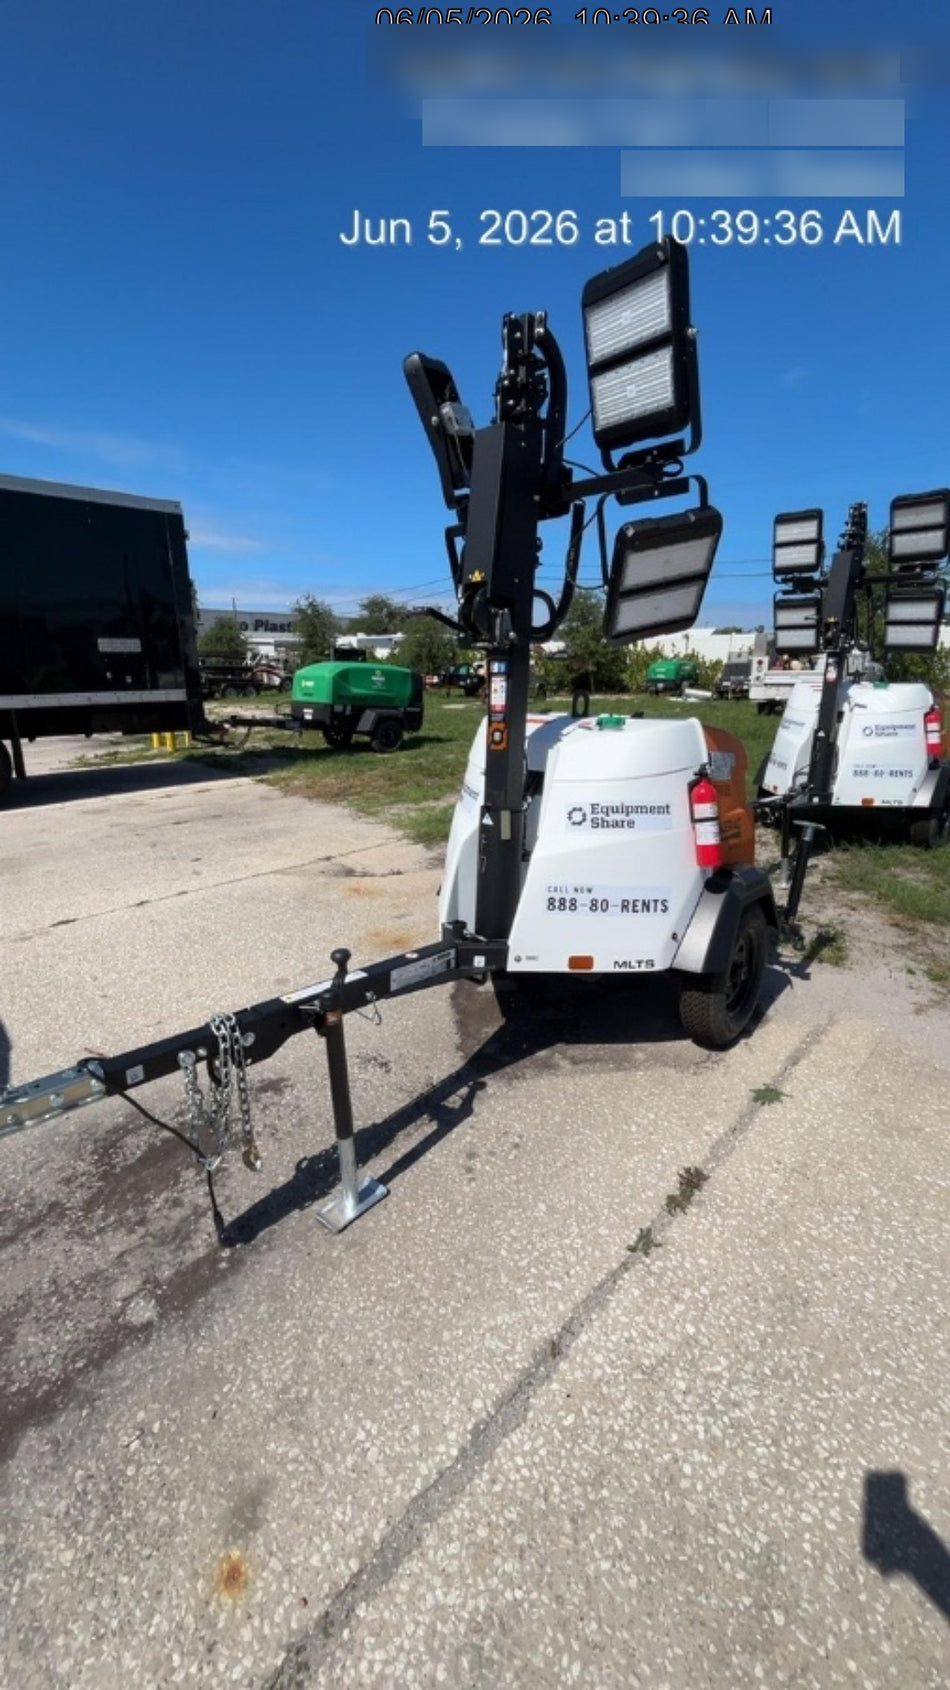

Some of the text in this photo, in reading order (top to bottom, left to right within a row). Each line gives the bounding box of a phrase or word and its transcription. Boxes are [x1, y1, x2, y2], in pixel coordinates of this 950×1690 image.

[590, 803, 671, 817] Equipment
[590, 817, 636, 829] Share
[546, 896, 670, 914] 888-80-RENTS
[613, 959, 656, 970] MLTS
